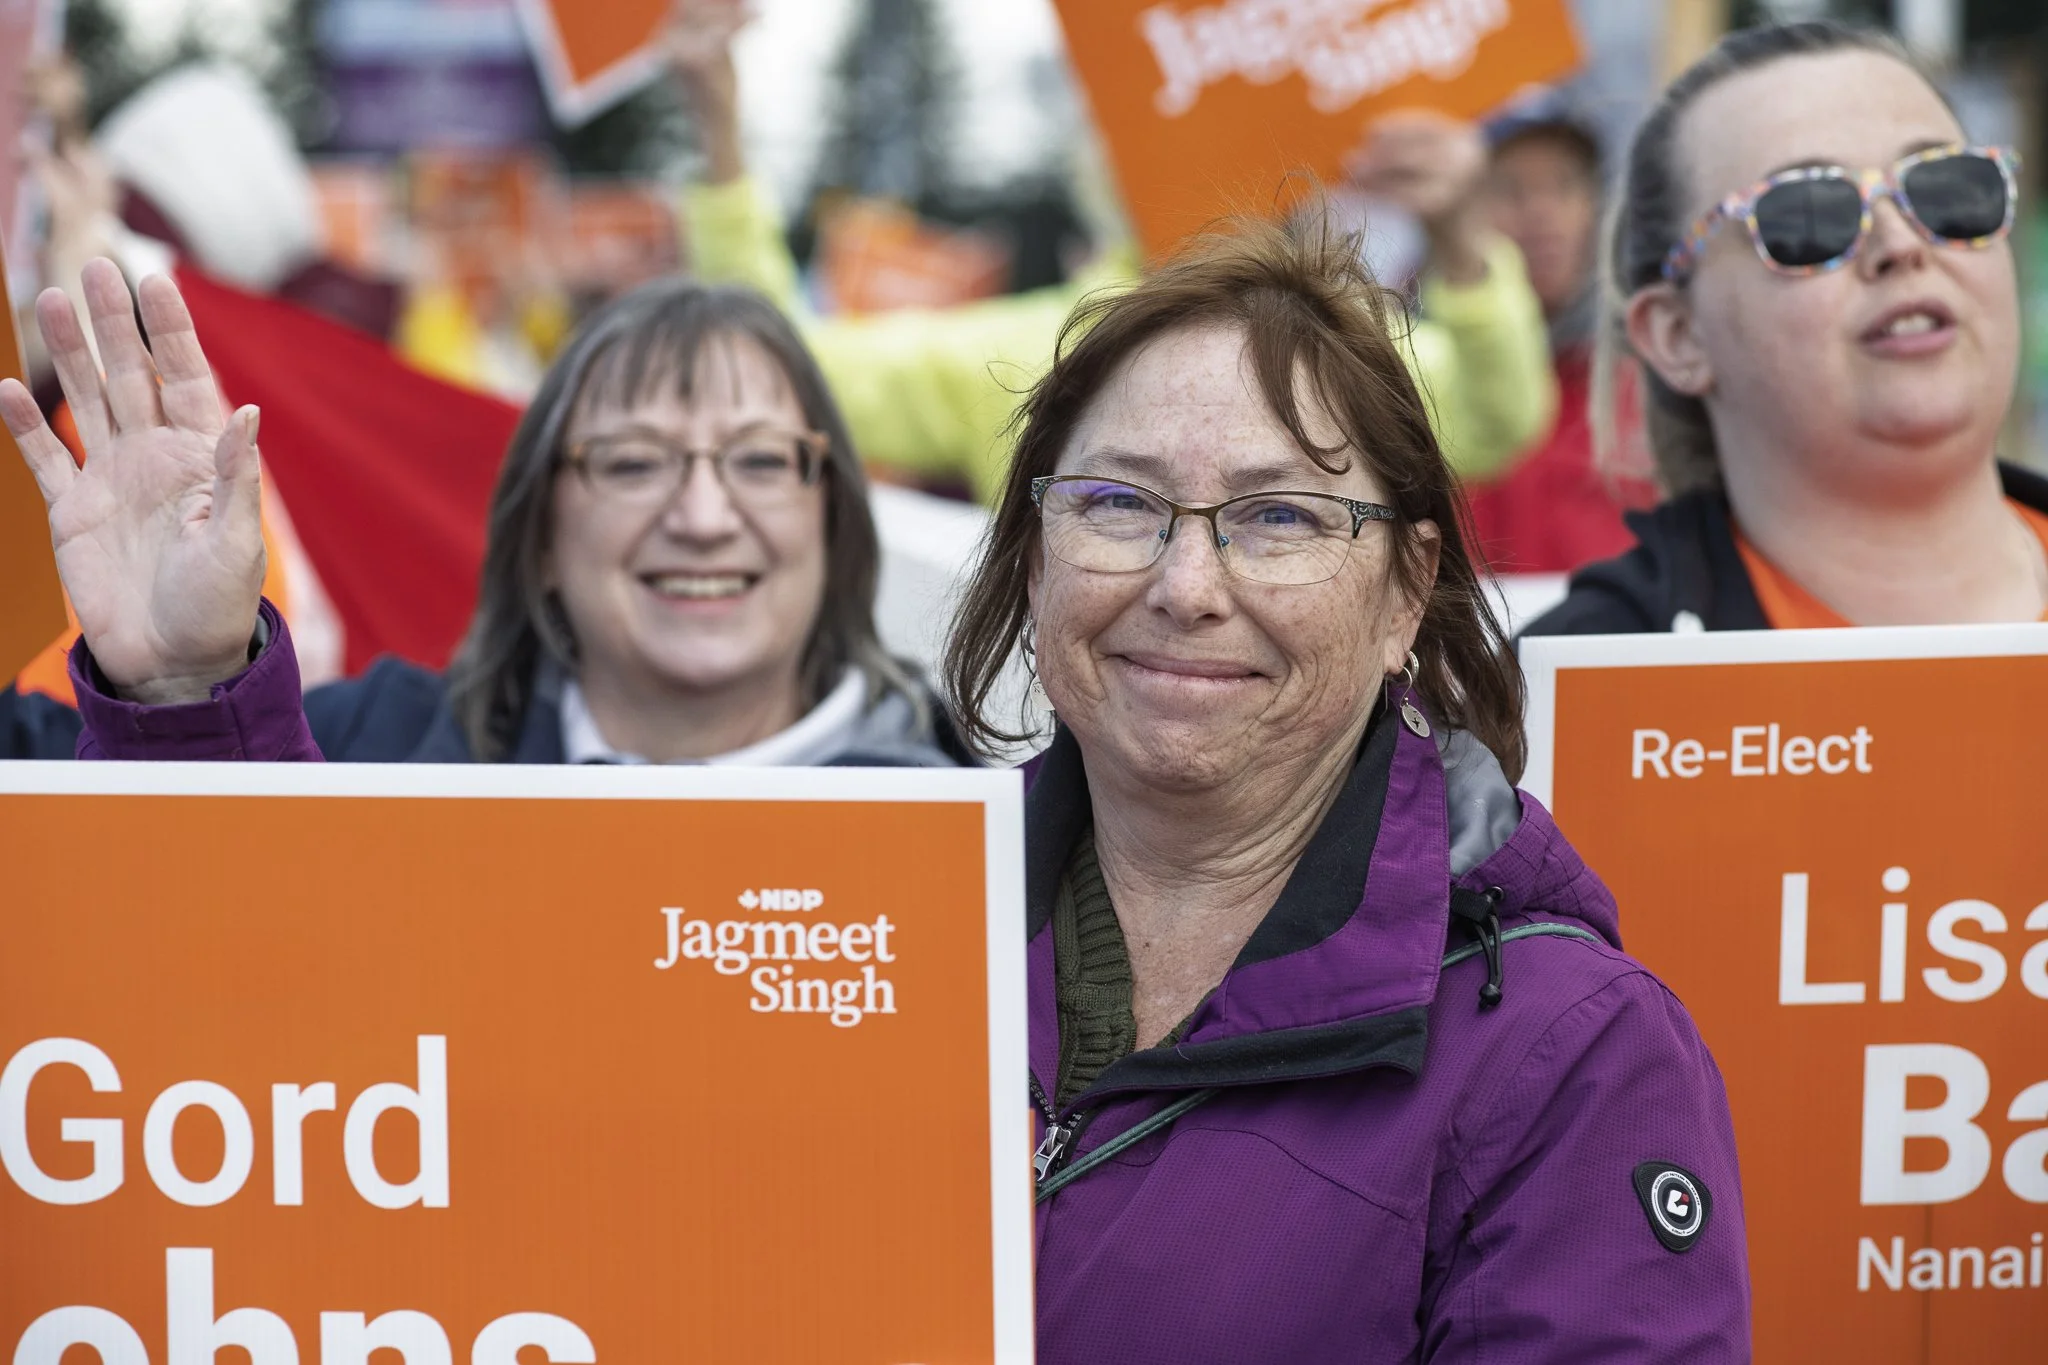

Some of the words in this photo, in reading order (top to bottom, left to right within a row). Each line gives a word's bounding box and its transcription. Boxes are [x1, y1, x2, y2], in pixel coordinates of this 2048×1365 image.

[1631, 723, 1873, 779] Re-Elect
[760, 889, 824, 911] NDP
[654, 907, 896, 976] Jagmeet
[749, 965, 898, 1028] Singh
[0, 1034, 451, 1209] Gord
